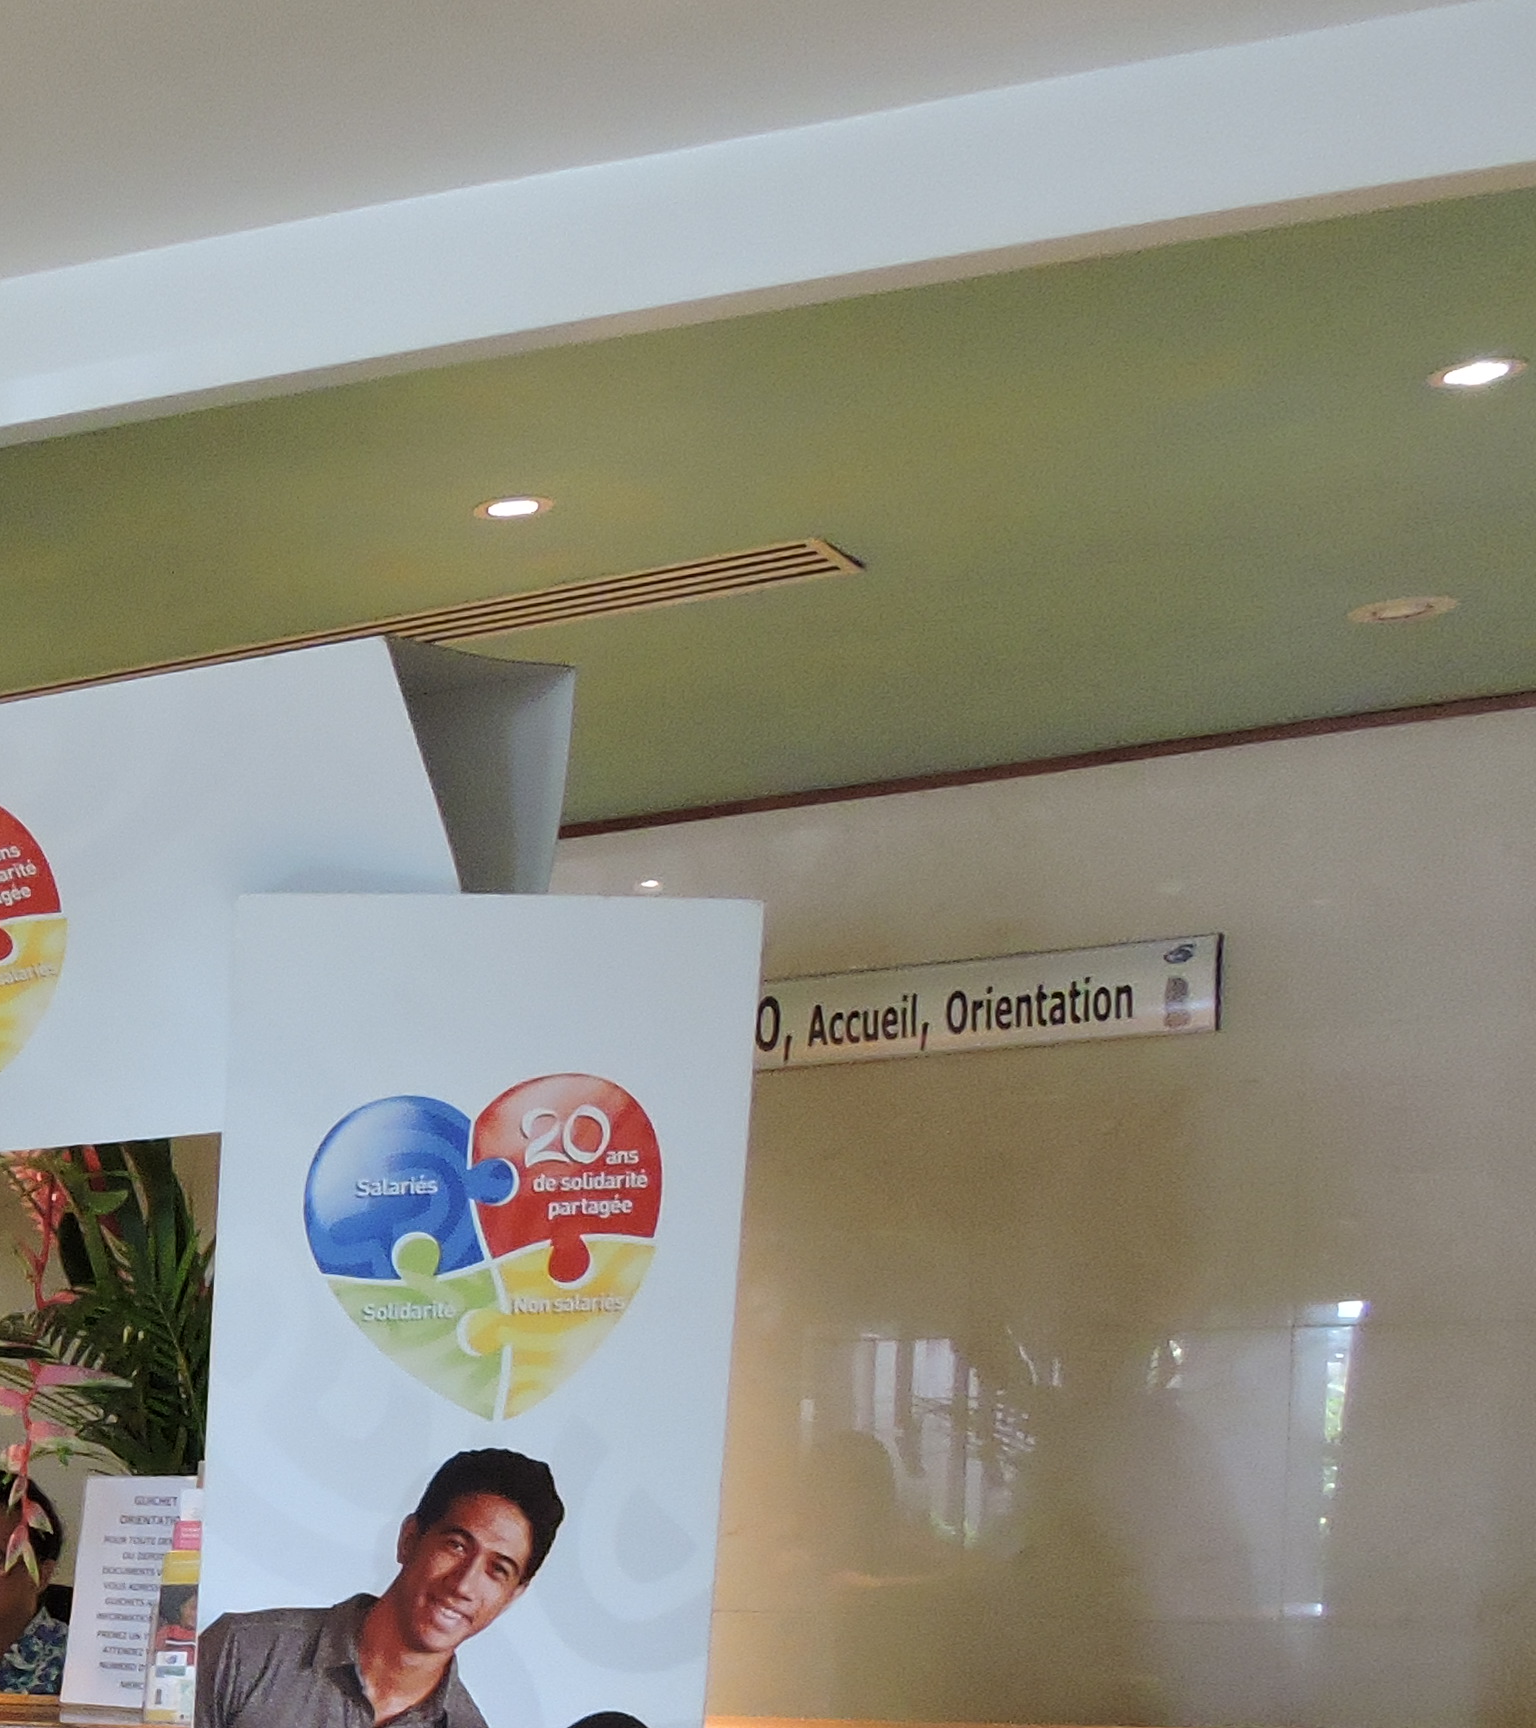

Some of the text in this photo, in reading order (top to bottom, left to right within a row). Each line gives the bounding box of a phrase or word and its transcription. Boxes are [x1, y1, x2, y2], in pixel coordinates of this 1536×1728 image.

[808, 993, 929, 1051] Accueil,
[946, 977, 1134, 1034] Orientation
[521, 1104, 639, 1167] 20 ans
[355, 1176, 438, 1197] Salariés
[533, 1168, 647, 1192] de solidarité
[548, 1195, 632, 1220] partagée
[362, 1301, 455, 1323] Solidarité
[512, 1293, 625, 1315] Non salariés
